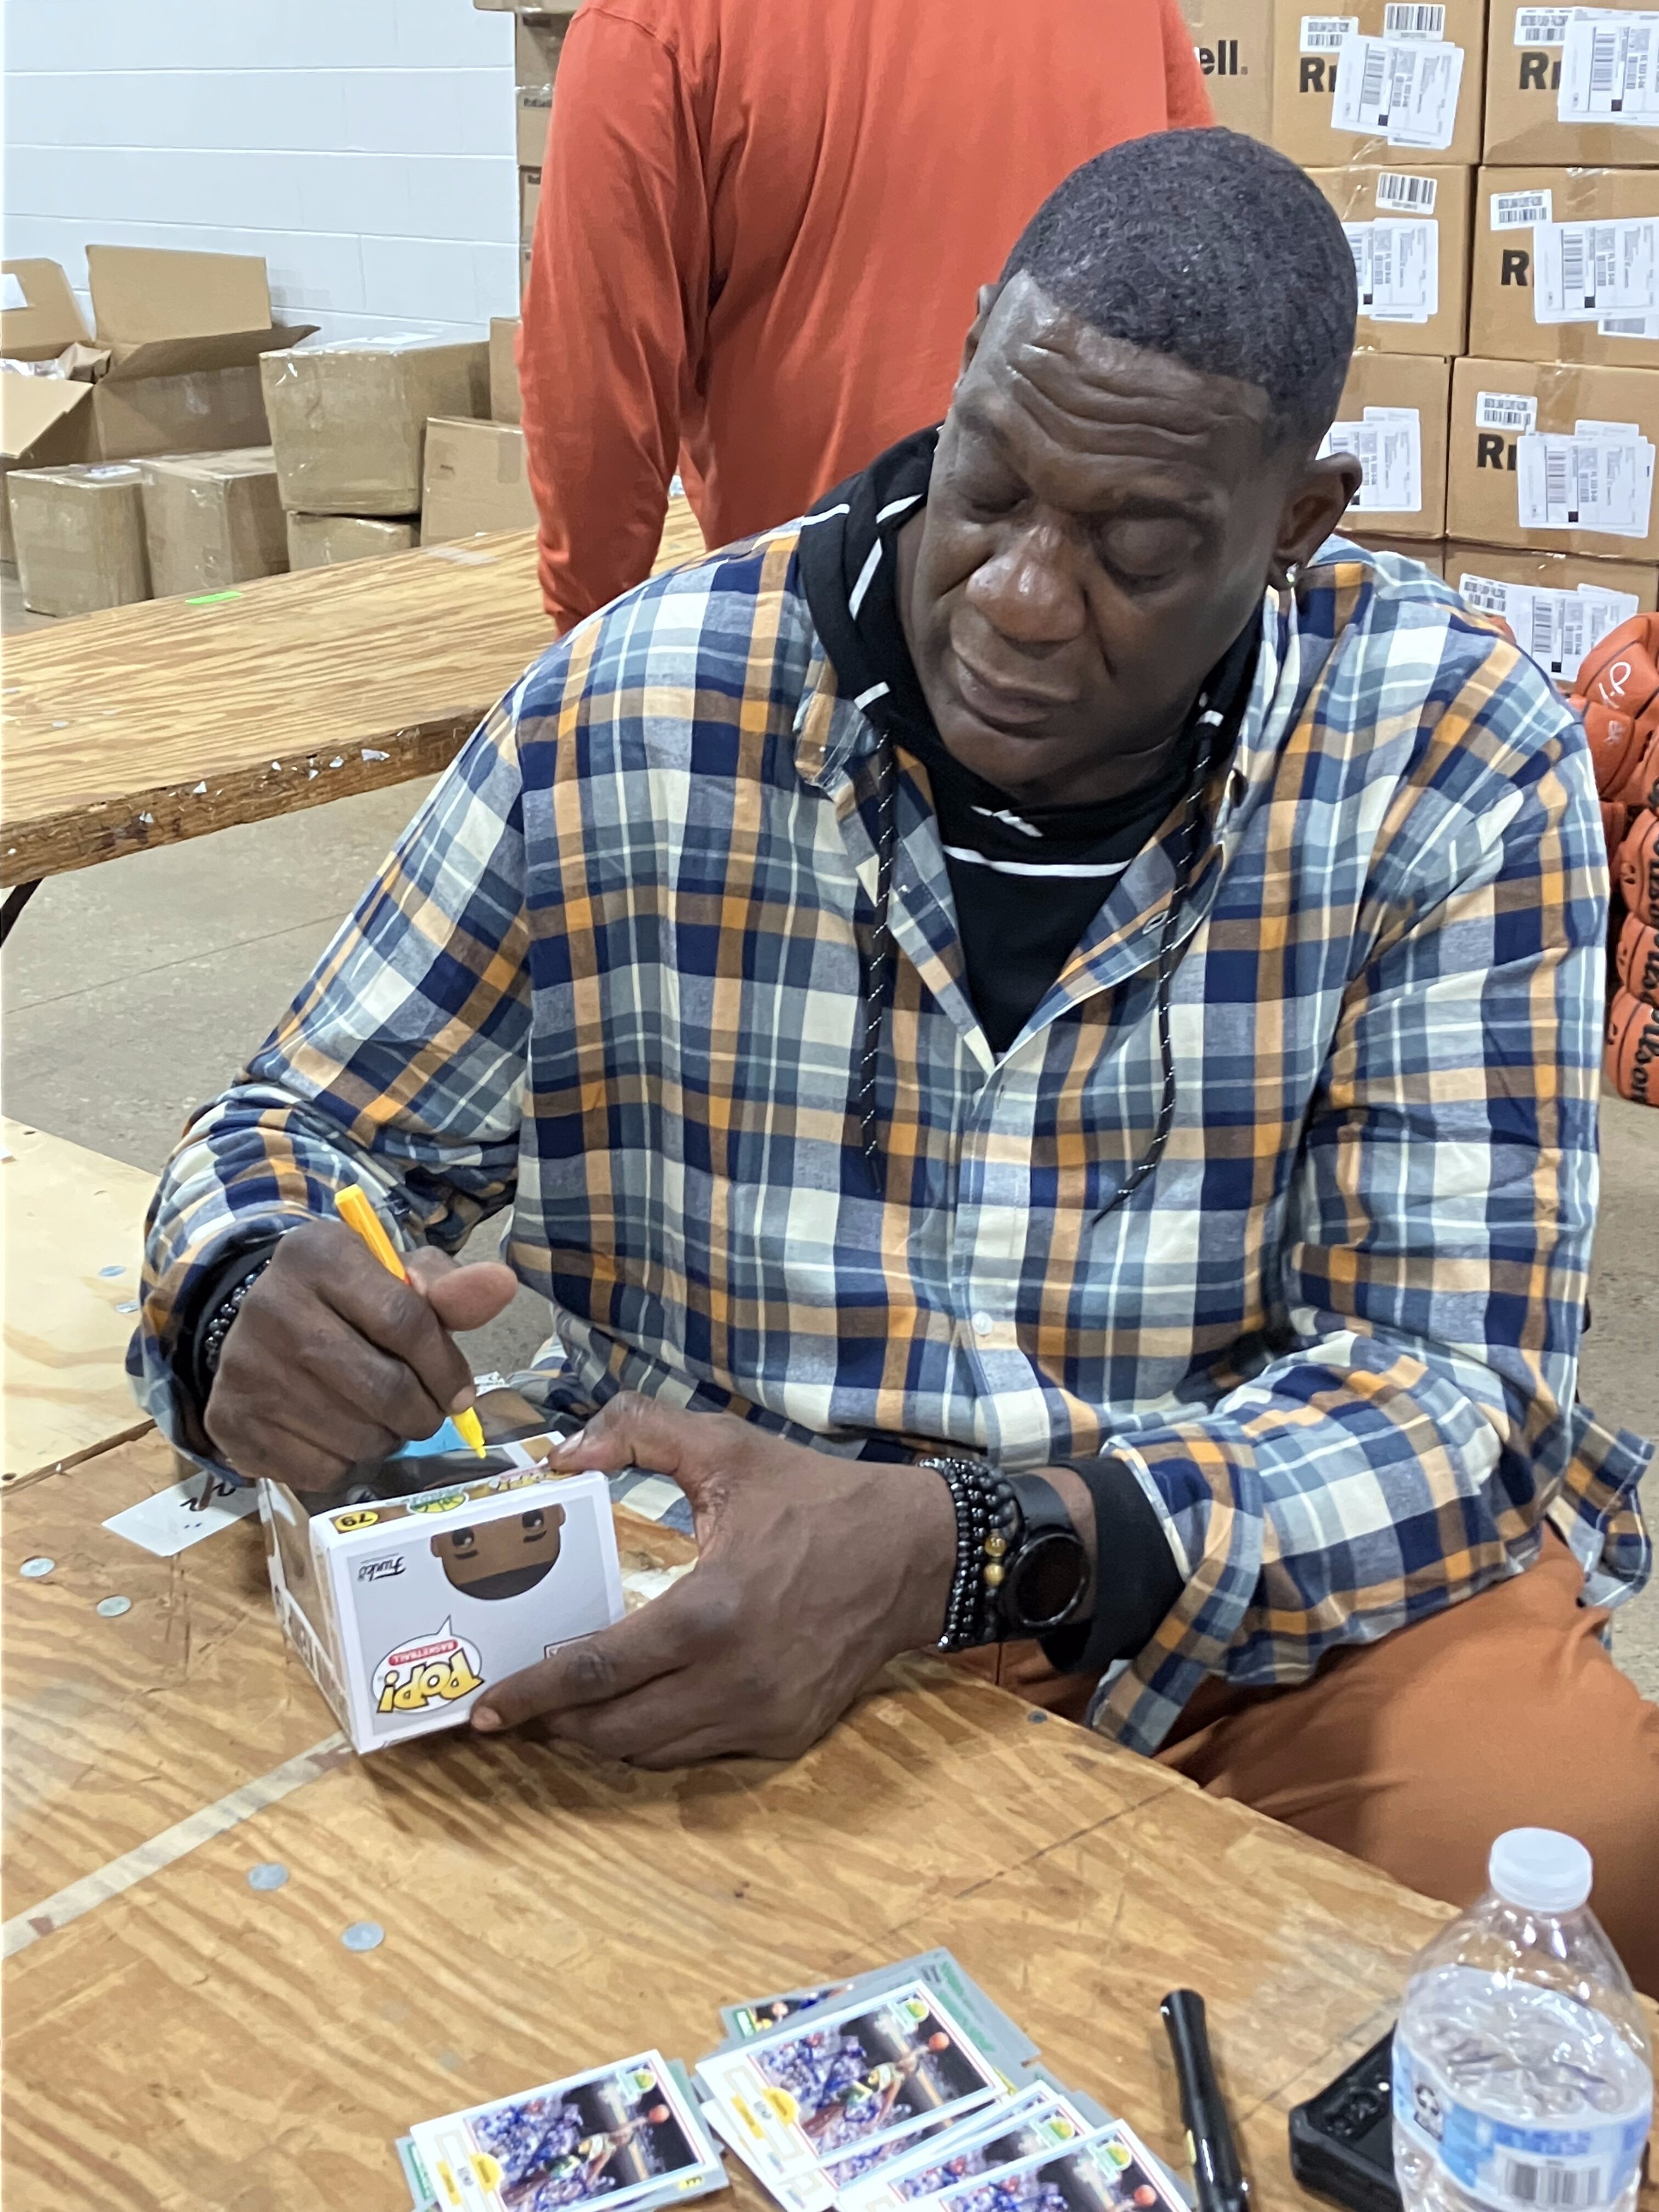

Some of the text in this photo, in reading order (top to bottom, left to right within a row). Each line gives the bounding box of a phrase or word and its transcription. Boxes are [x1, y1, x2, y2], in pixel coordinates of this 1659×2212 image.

[341, 1513, 374, 1527] 79
[357, 1556, 406, 1582] Funko
[392, 1640, 456, 1664] BASKETBALL
[376, 1647, 486, 1713] POP!
